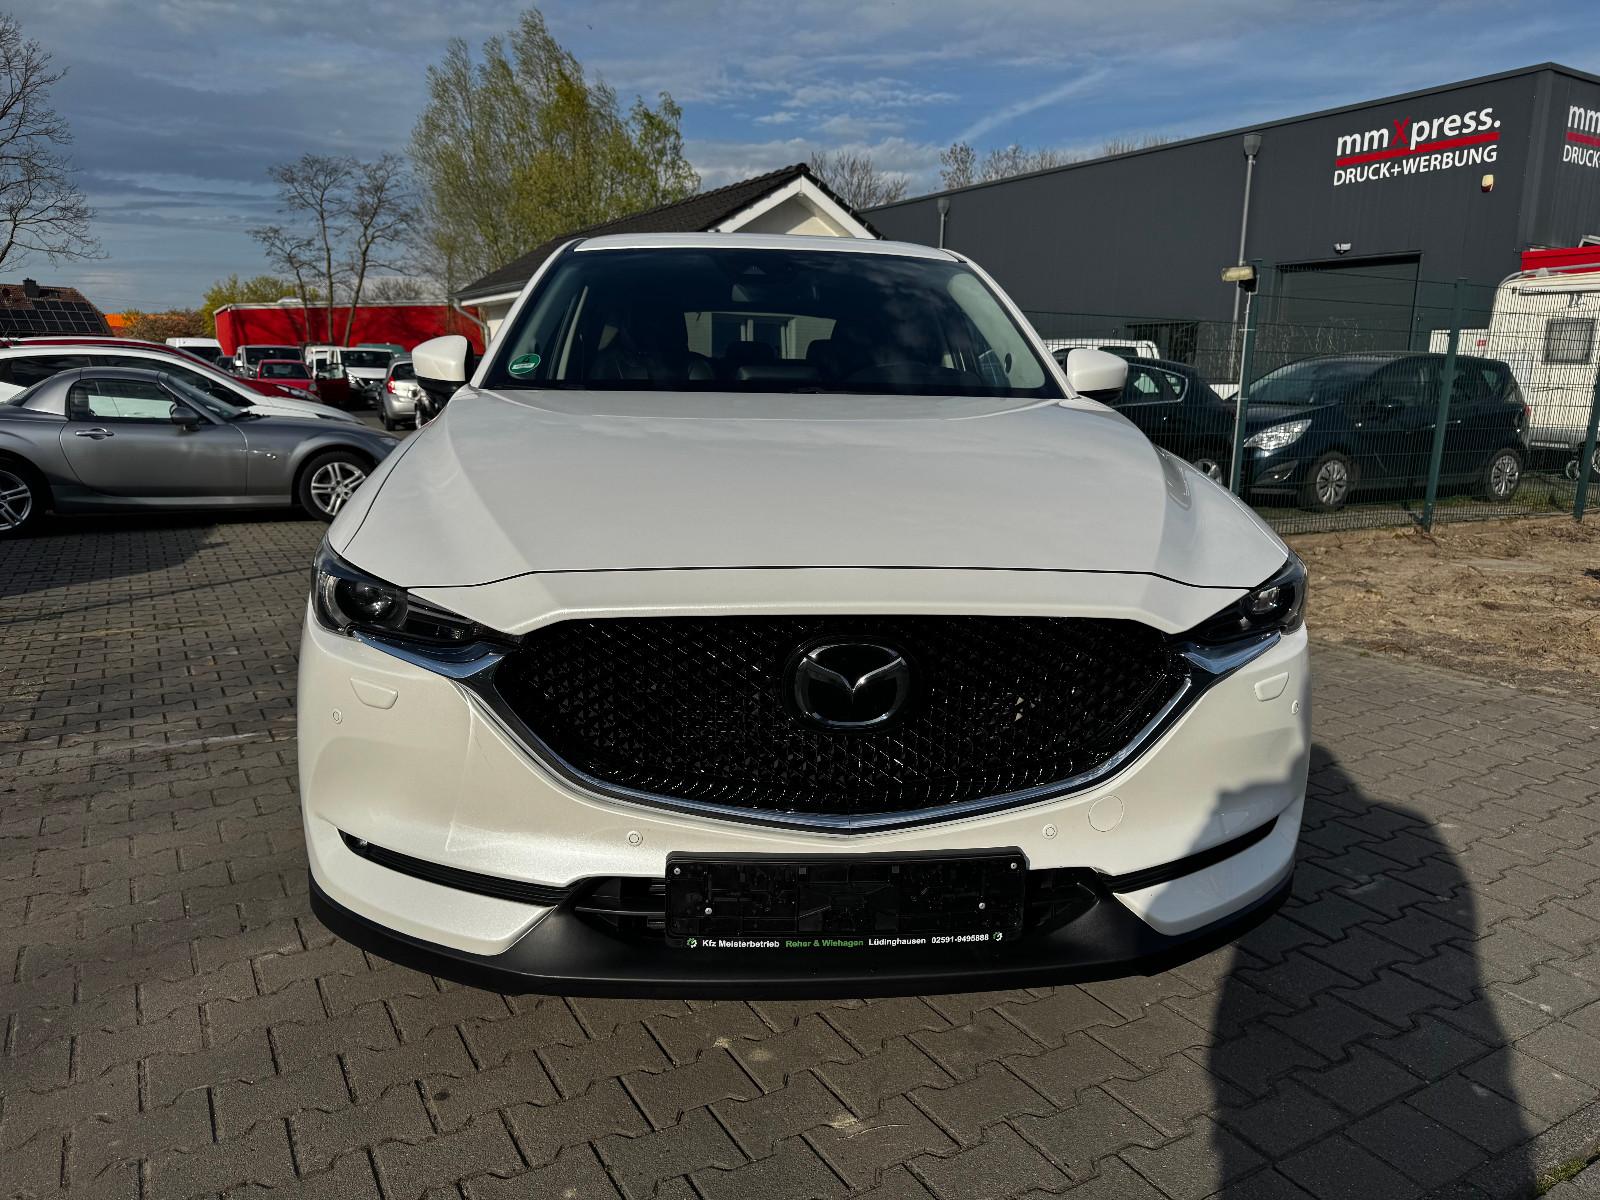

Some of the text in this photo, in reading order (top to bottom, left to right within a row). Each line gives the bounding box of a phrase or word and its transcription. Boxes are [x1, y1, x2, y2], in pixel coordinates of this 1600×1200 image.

[1336, 107, 1501, 156] mmXpress.
[1333, 144, 1498, 186] DRUCK+WERBUNG
[1562, 144, 1600, 168] DRUCK
[702, 939, 717, 947] Kfz
[718, 939, 780, 948] Meisterbetrieb
[813, 939, 820, 947] &
[868, 937, 926, 947] Lüdinghausen
